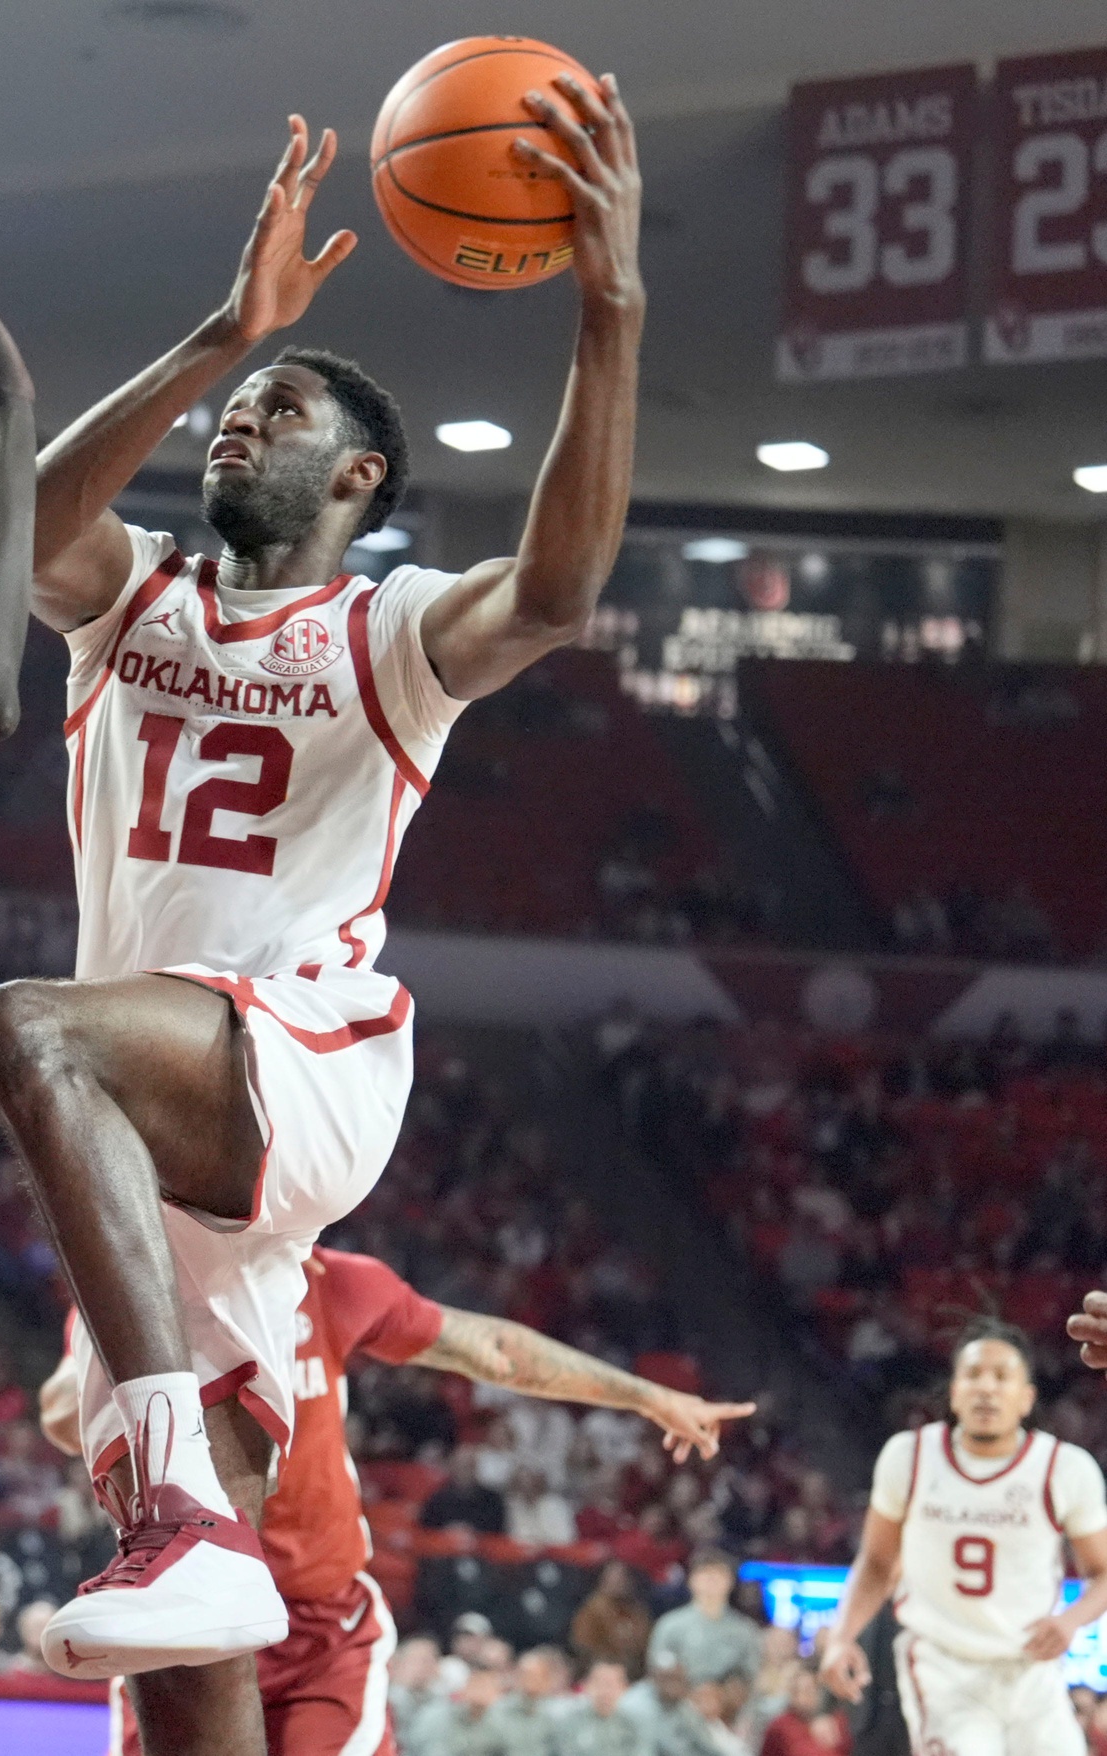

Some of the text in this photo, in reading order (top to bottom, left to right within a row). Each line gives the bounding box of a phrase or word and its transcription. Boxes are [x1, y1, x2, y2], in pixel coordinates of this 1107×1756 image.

[817, 96, 953, 147] ADAMS
[804, 148, 956, 293] 33
[1012, 132, 1107, 276] 2
[454, 243, 575, 274] ELITE
[268, 654, 333, 675] GRADUATE
[274, 620, 327, 661] SEC
[118, 650, 338, 717] OKLAHOMA
[127, 711, 295, 876] 12
[953, 1535, 995, 1597] 9
